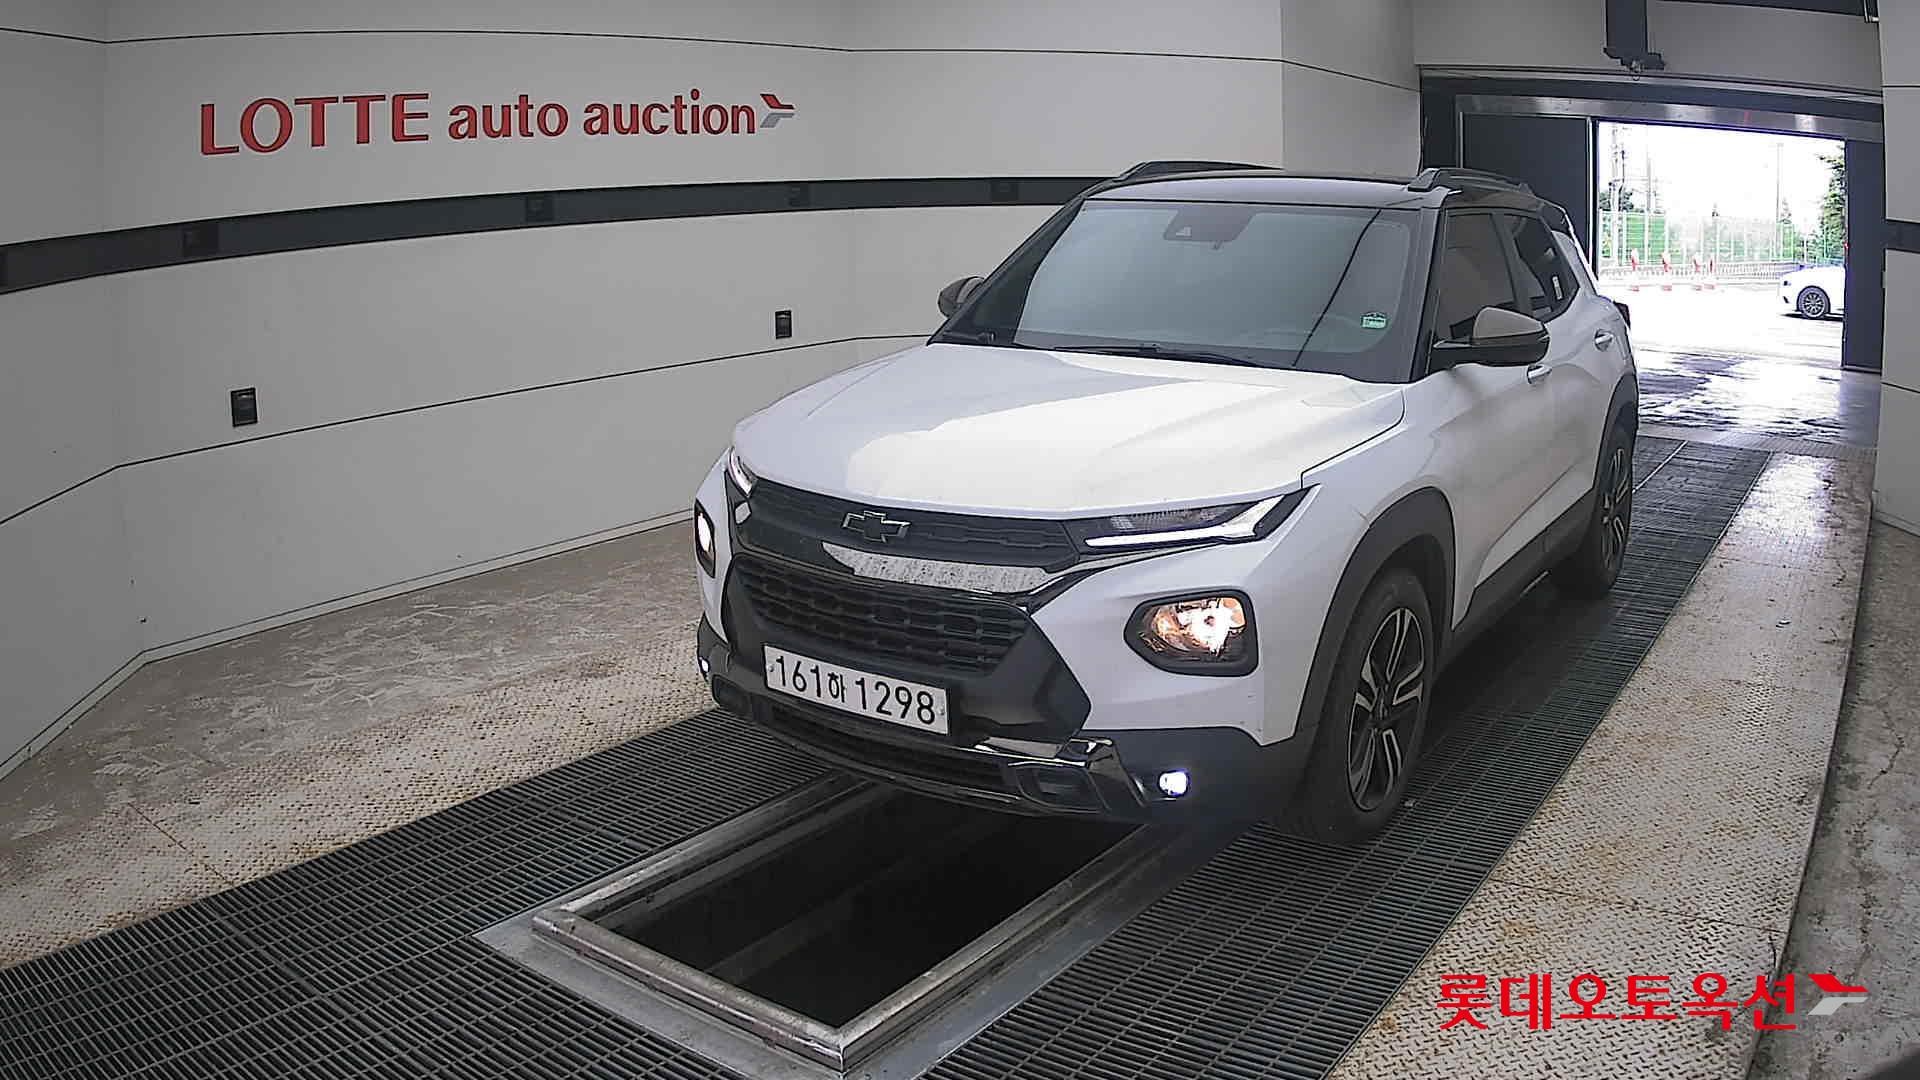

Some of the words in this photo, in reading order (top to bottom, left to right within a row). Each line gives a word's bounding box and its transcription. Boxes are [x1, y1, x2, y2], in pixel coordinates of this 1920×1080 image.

[200, 93, 430, 156] LOTTE
[447, 94, 569, 140] auto
[583, 89, 756, 136] auction
[855, 677, 936, 725] 1298
